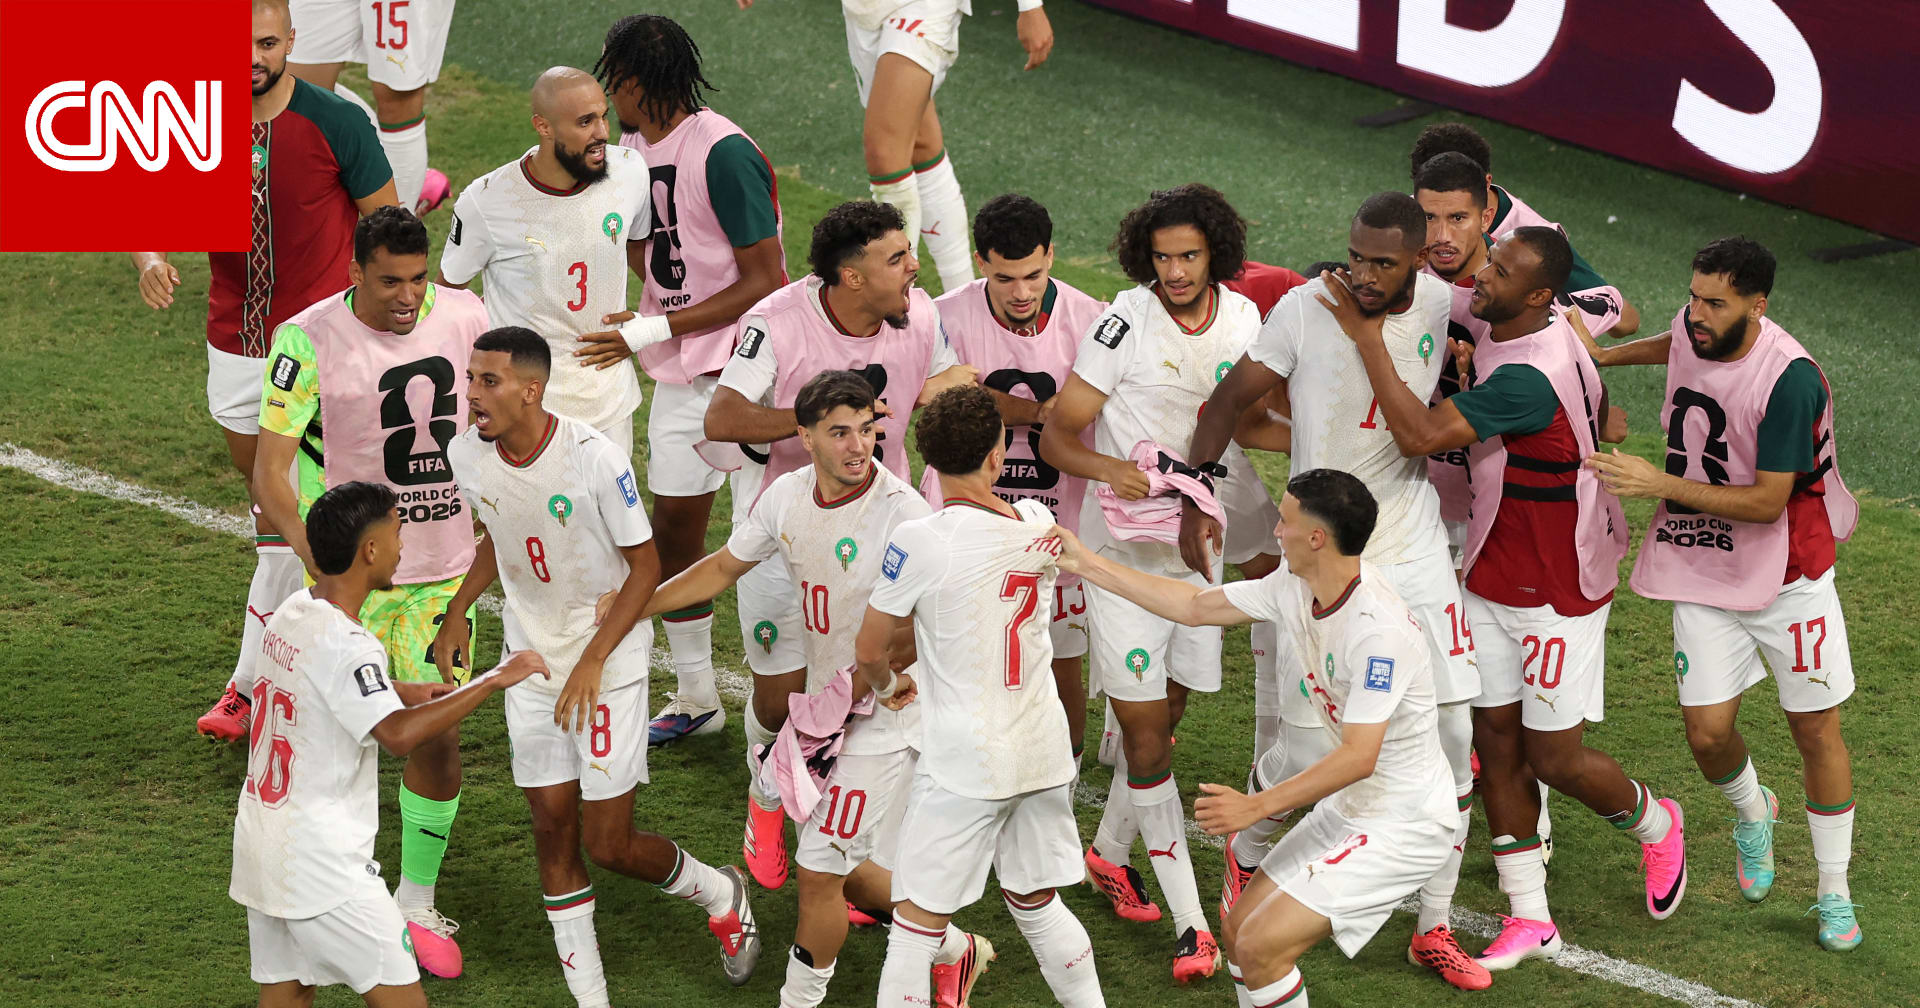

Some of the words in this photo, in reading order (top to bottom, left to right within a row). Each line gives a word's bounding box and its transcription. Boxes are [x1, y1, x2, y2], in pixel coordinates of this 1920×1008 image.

[371, 2, 408, 50] 15
[567, 261, 588, 312] 3
[408, 457, 446, 474] FIFA
[1001, 465, 1039, 479] FIFA
[396, 498, 461, 523] 2026
[1709, 519, 1733, 533] CUP
[525, 536, 551, 583] 8
[1657, 528, 1734, 552] 2026
[802, 581, 829, 635] 10
[999, 571, 1044, 691] 7
[262, 630, 300, 672] YASSINE
[1521, 635, 1566, 689] 20
[1787, 616, 1827, 672] 17
[247, 676, 297, 810] 16
[590, 704, 612, 758] 8
[819, 785, 867, 840] 10
